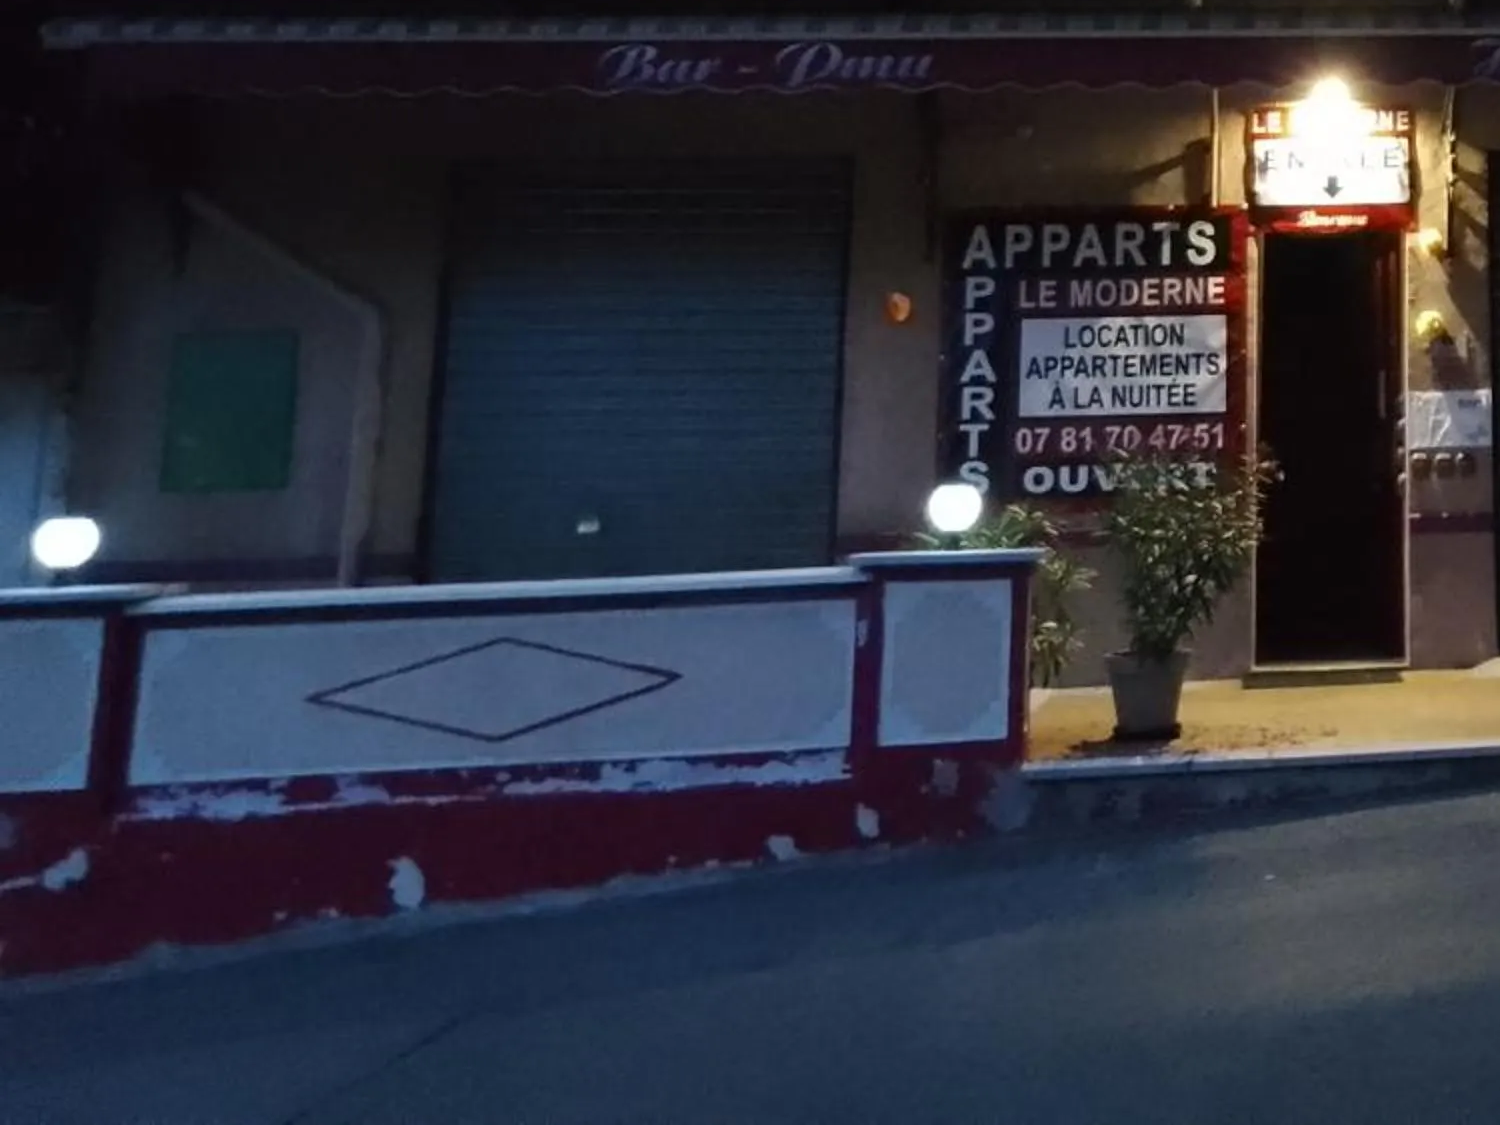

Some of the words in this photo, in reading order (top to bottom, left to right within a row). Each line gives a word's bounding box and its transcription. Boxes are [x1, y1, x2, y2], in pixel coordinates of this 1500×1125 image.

[600, 41, 721, 85] Bar
[961, 219, 1217, 269] APPARTS
[1018, 279, 1057, 309] LE
[1070, 275, 1226, 307] MODERNE
[1064, 323, 1185, 348] LOCATION
[1026, 353, 1220, 379] APPARTEMENTS
[1049, 380, 1066, 409] À
[1073, 385, 1104, 410] LA
[1111, 379, 1197, 408] NUITÉE
[1014, 427, 1051, 454] 07
[1060, 426, 1093, 453] 81
[1105, 425, 1142, 452] 70
[1149, 424, 1186, 450] 47
[1193, 422, 1225, 449] 51
